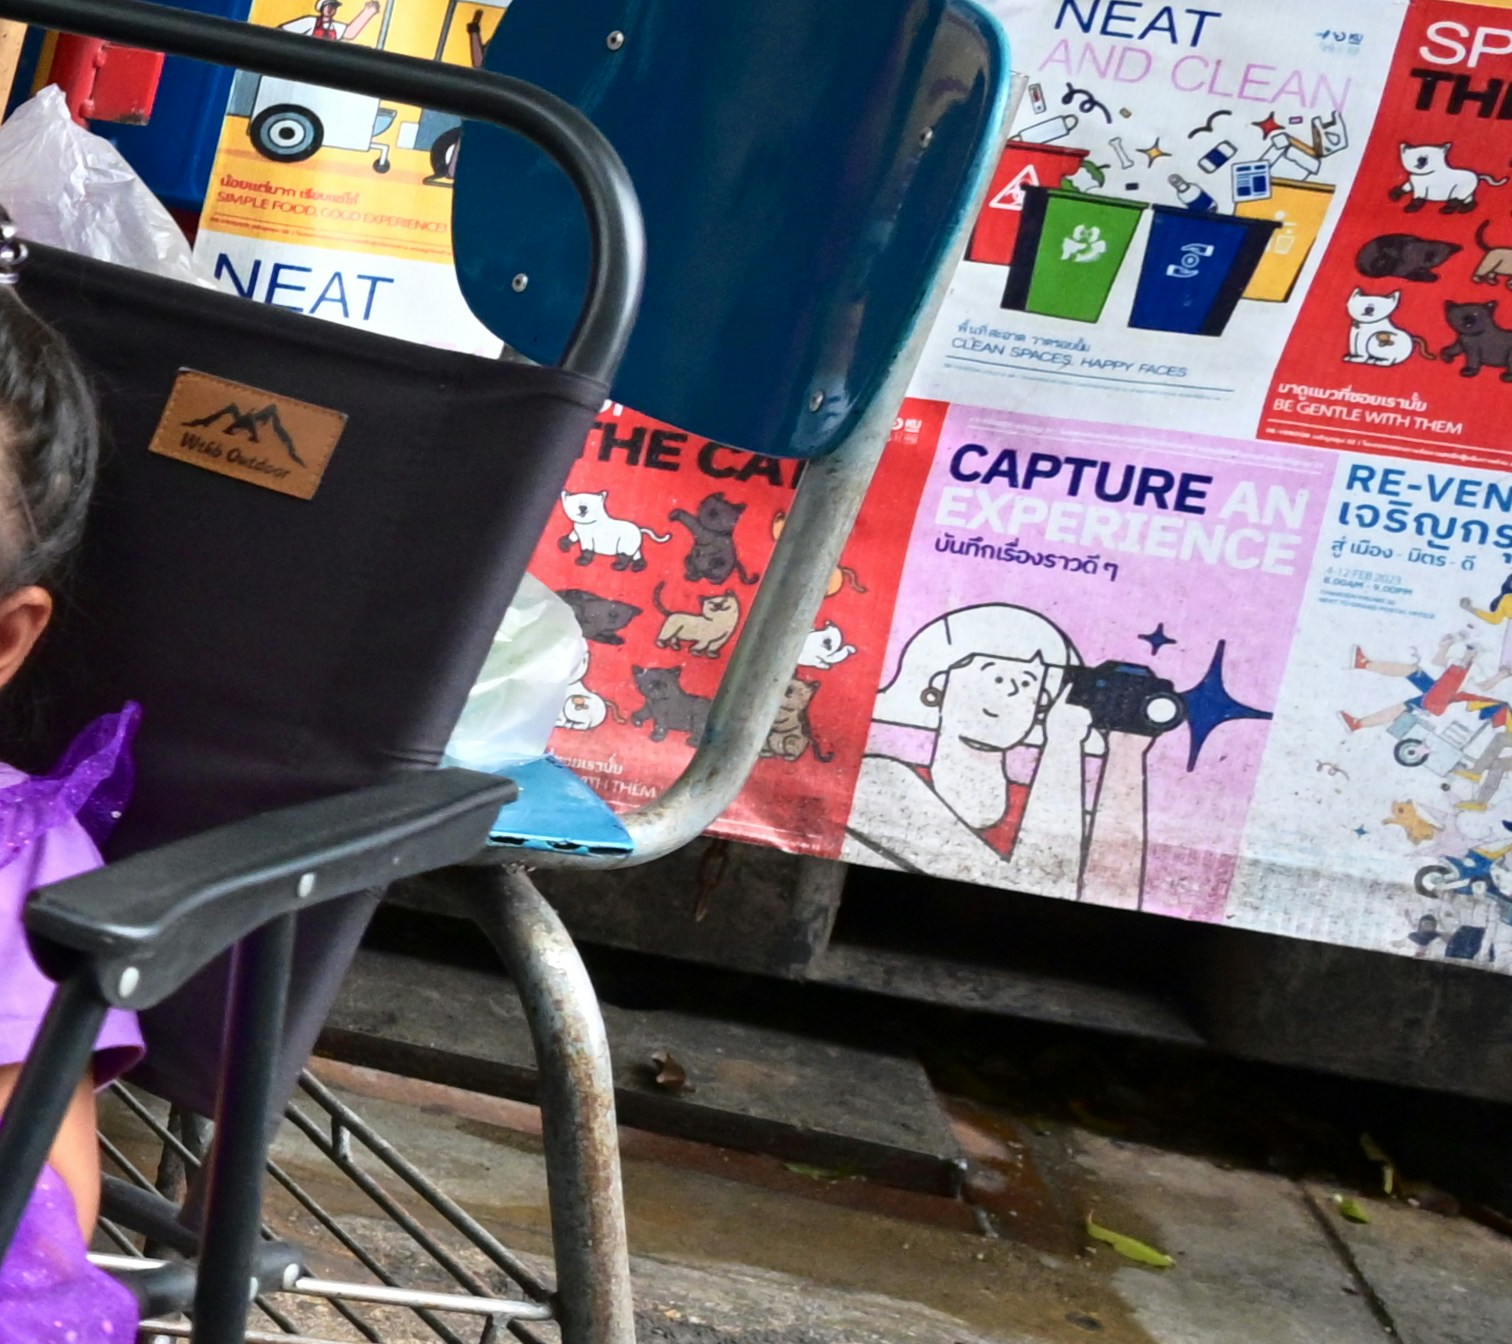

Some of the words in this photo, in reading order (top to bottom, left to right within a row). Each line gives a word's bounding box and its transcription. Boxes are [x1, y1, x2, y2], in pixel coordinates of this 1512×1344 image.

[1038, 39, 1153, 83] AND
[1170, 54, 1353, 113] CLEAN
[1410, 67, 1512, 121] TH
[216, 191, 269, 210] SIMPLE
[214, 253, 395, 323] NEAT
[951, 336, 1005, 356] CLEAN
[1080, 357, 1134, 372] HAPPY
[1138, 363, 1189, 378] FACES
[1272, 397, 1293, 411] BE
[1296, 401, 1362, 422] GENTLE
[1364, 410, 1411, 429] WITH
[1413, 416, 1464, 436] THEM
[594, 420, 688, 473] HE
[949, 443, 1213, 516] CAPTURE
[1218, 479, 1309, 531] AN
[934, 486, 1302, 577] EXPERIENCE
[1331, 536, 1347, 558] สู่
[1350, 539, 1394, 560] เมือง
[1407, 547, 1447, 567] มิตร
[1460, 555, 1477, 571] ดี
[613, 779, 657, 799] THEM
